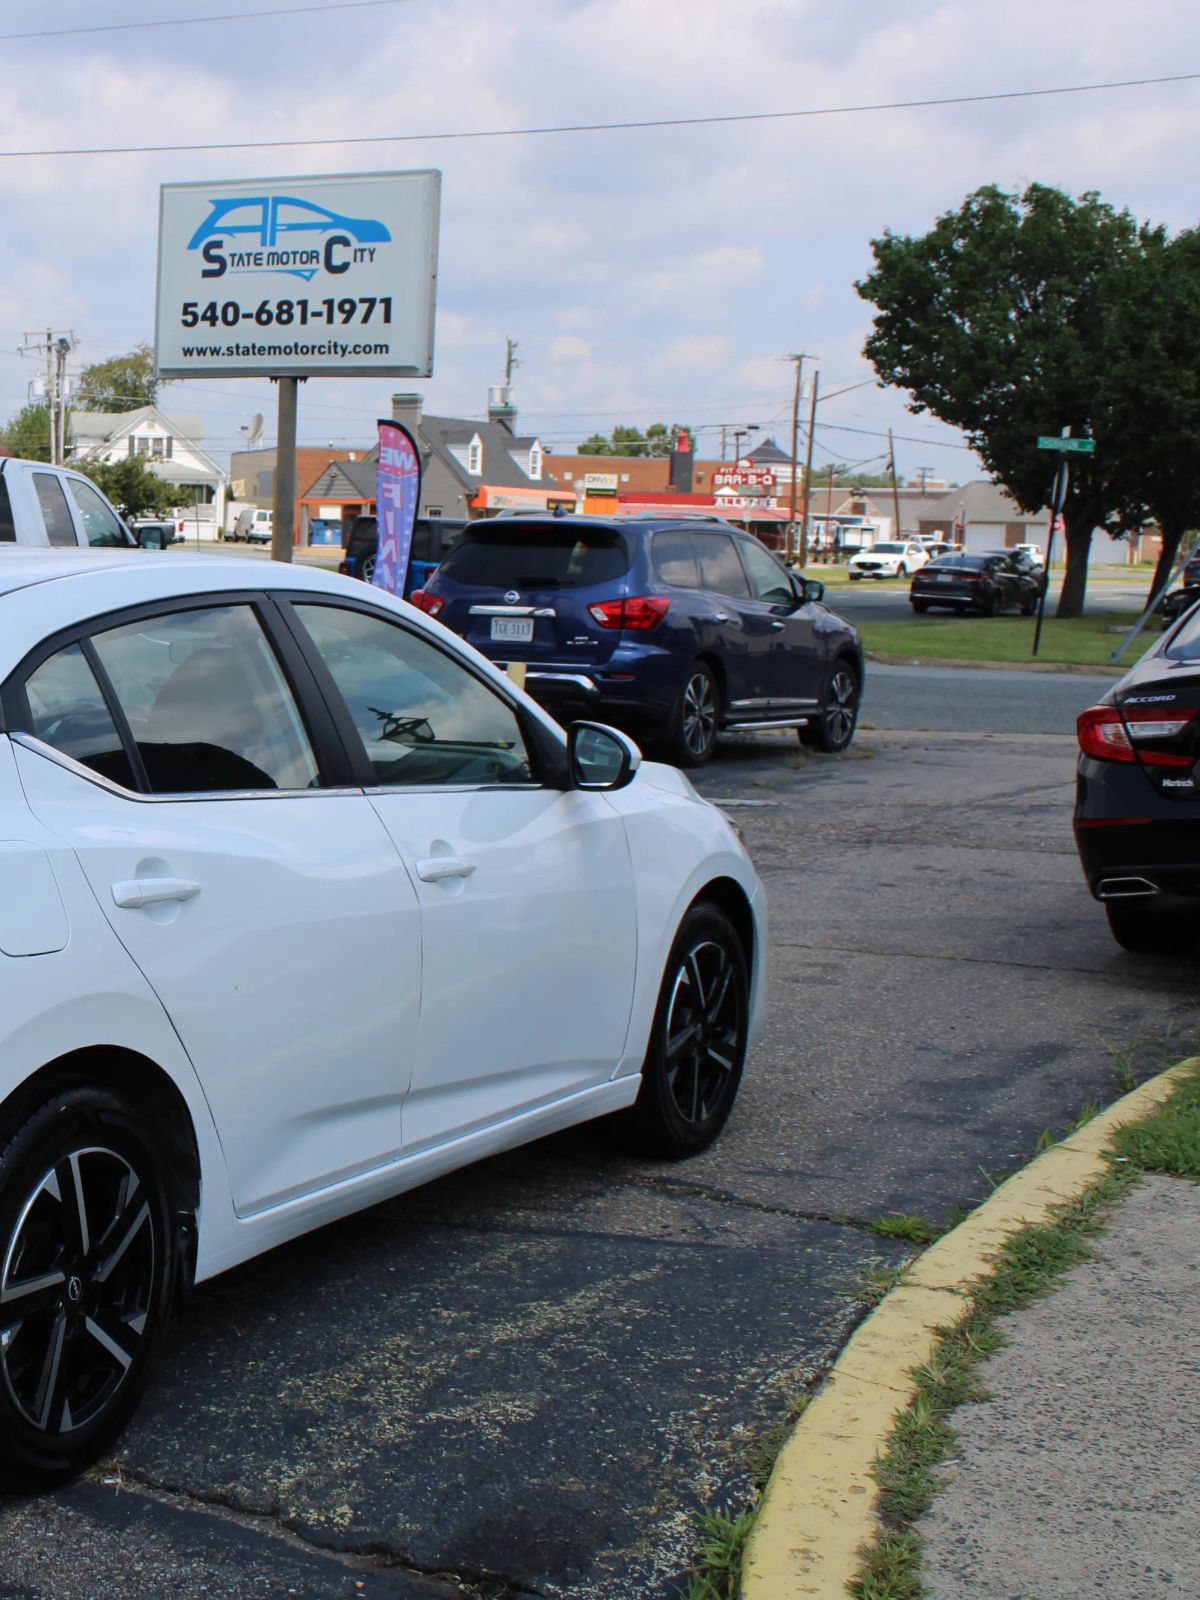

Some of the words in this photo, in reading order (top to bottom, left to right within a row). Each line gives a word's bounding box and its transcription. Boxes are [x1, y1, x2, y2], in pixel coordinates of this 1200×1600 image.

[266, 250, 320, 267] MOTOR
[181, 297, 392, 327] 540-681-1971
[182, 340, 389, 357] www.statemotorcity.com
[714, 474, 773, 485] BAR-B-Q
[1124, 694, 1176, 704] ACCORD
